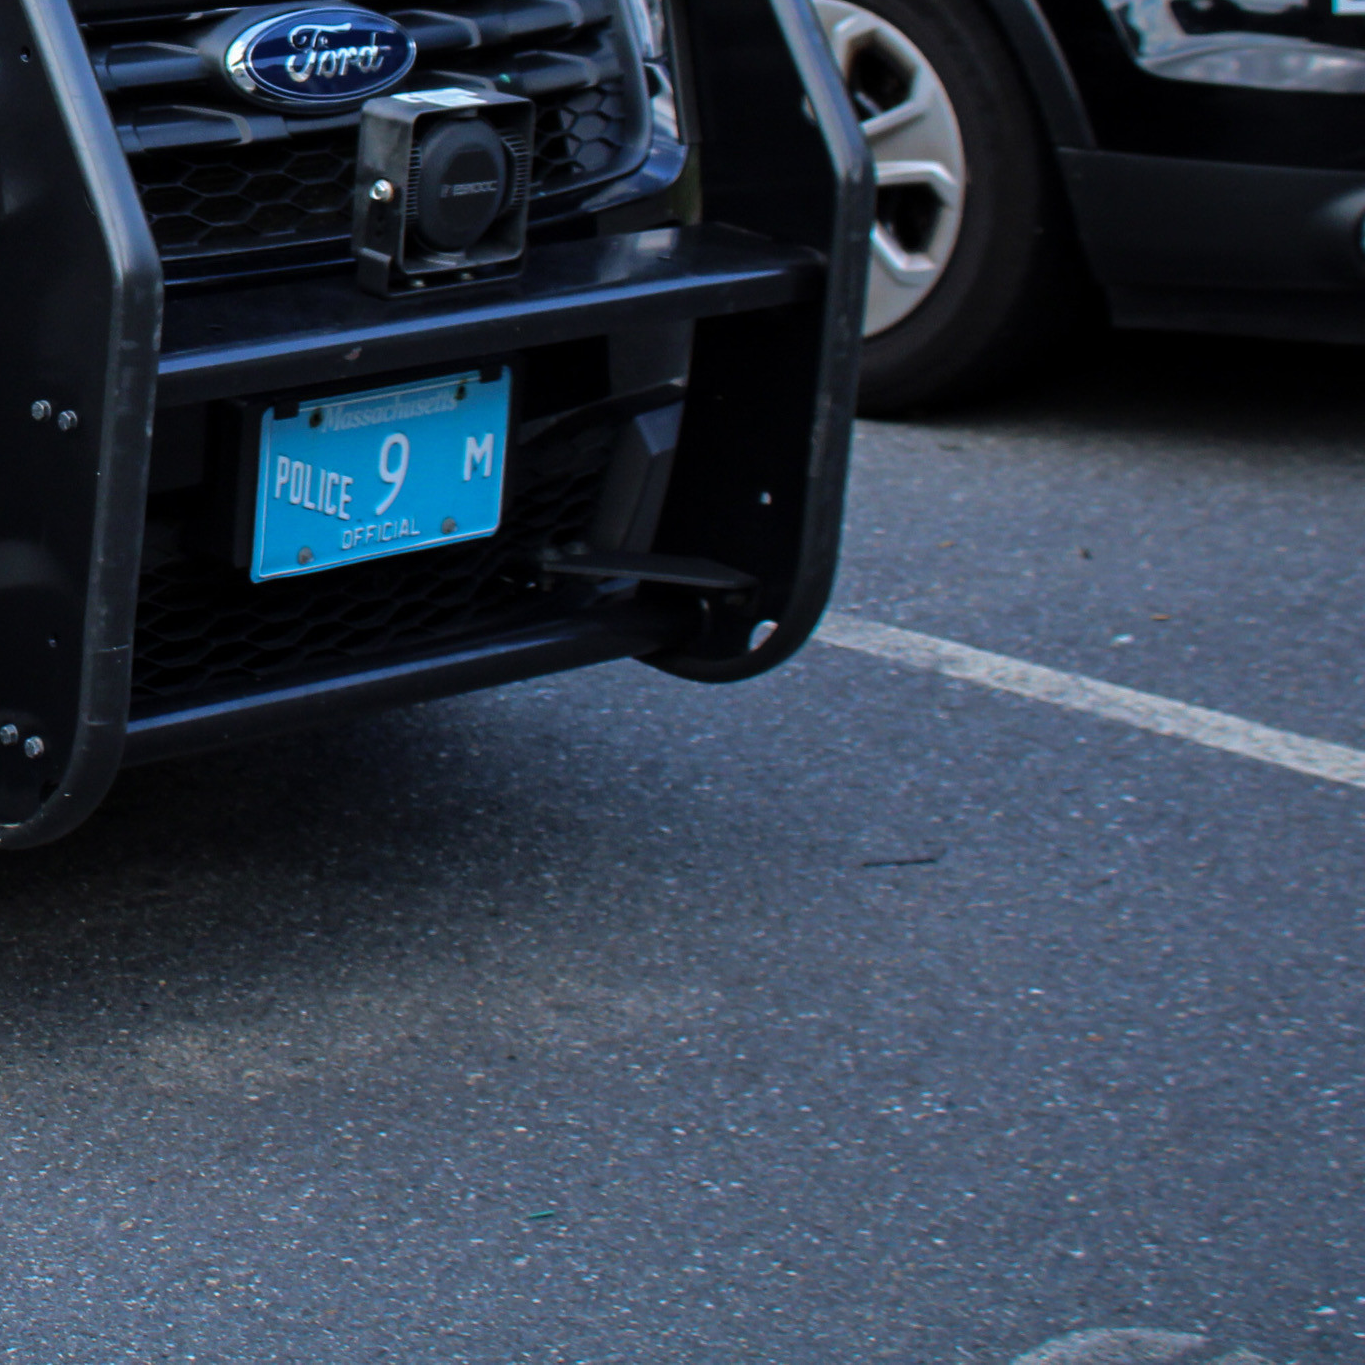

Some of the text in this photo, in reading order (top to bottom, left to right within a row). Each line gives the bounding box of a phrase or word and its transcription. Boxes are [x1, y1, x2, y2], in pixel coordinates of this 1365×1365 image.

[285, 22, 392, 83] Ford
[319, 387, 458, 434] Massachusetts
[274, 432, 495, 521] POLICE 9 M
[341, 518, 421, 551] OFFICIAL
